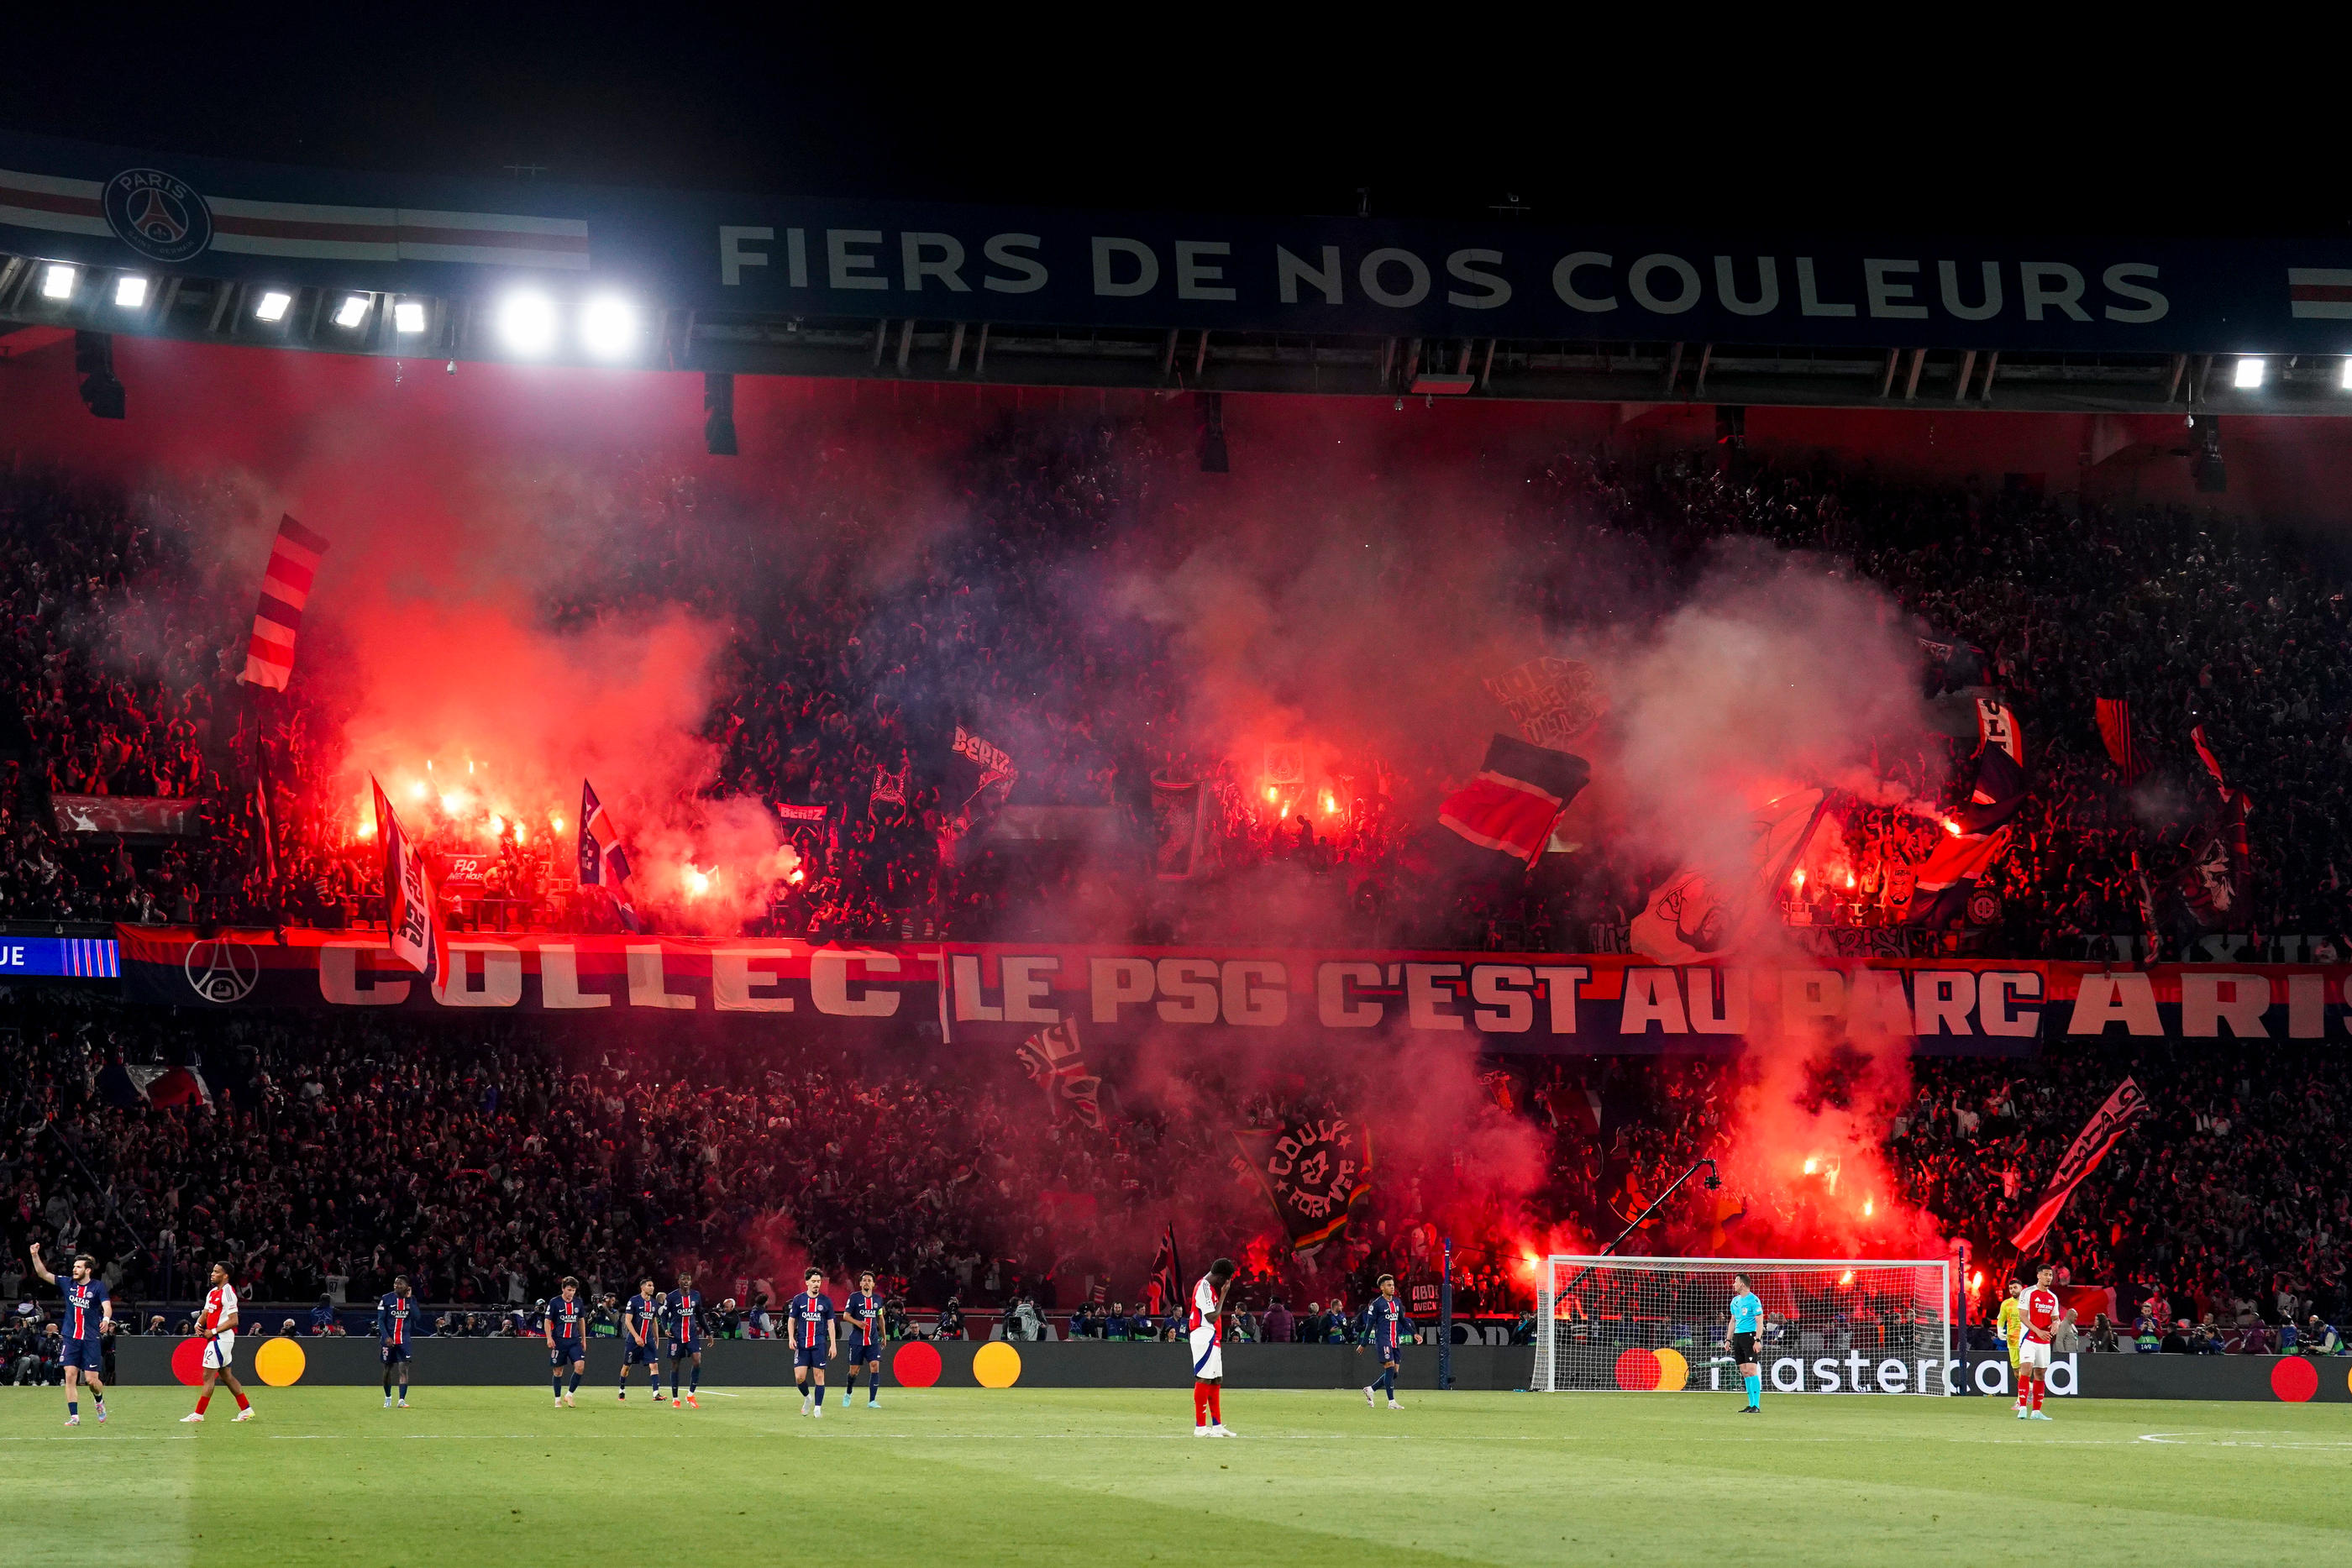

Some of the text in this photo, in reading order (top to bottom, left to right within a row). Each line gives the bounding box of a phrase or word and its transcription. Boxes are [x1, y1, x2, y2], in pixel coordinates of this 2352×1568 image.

[119, 173, 186, 199] PARIS
[719, 225, 2170, 323] FIERS DE NOS COULEURS
[952, 725, 1010, 775] BERIZ
[780, 807, 823, 821] BERIZ
[454, 859, 477, 873] FLO
[465, 871, 484, 882] NOUS
[952, 955, 2042, 1038] LE PSG C'EST AU PARC
[1299, 1151, 1329, 1185] 27
[69, 1295, 90, 1305] QATAR
[204, 1350, 213, 1361] 12
